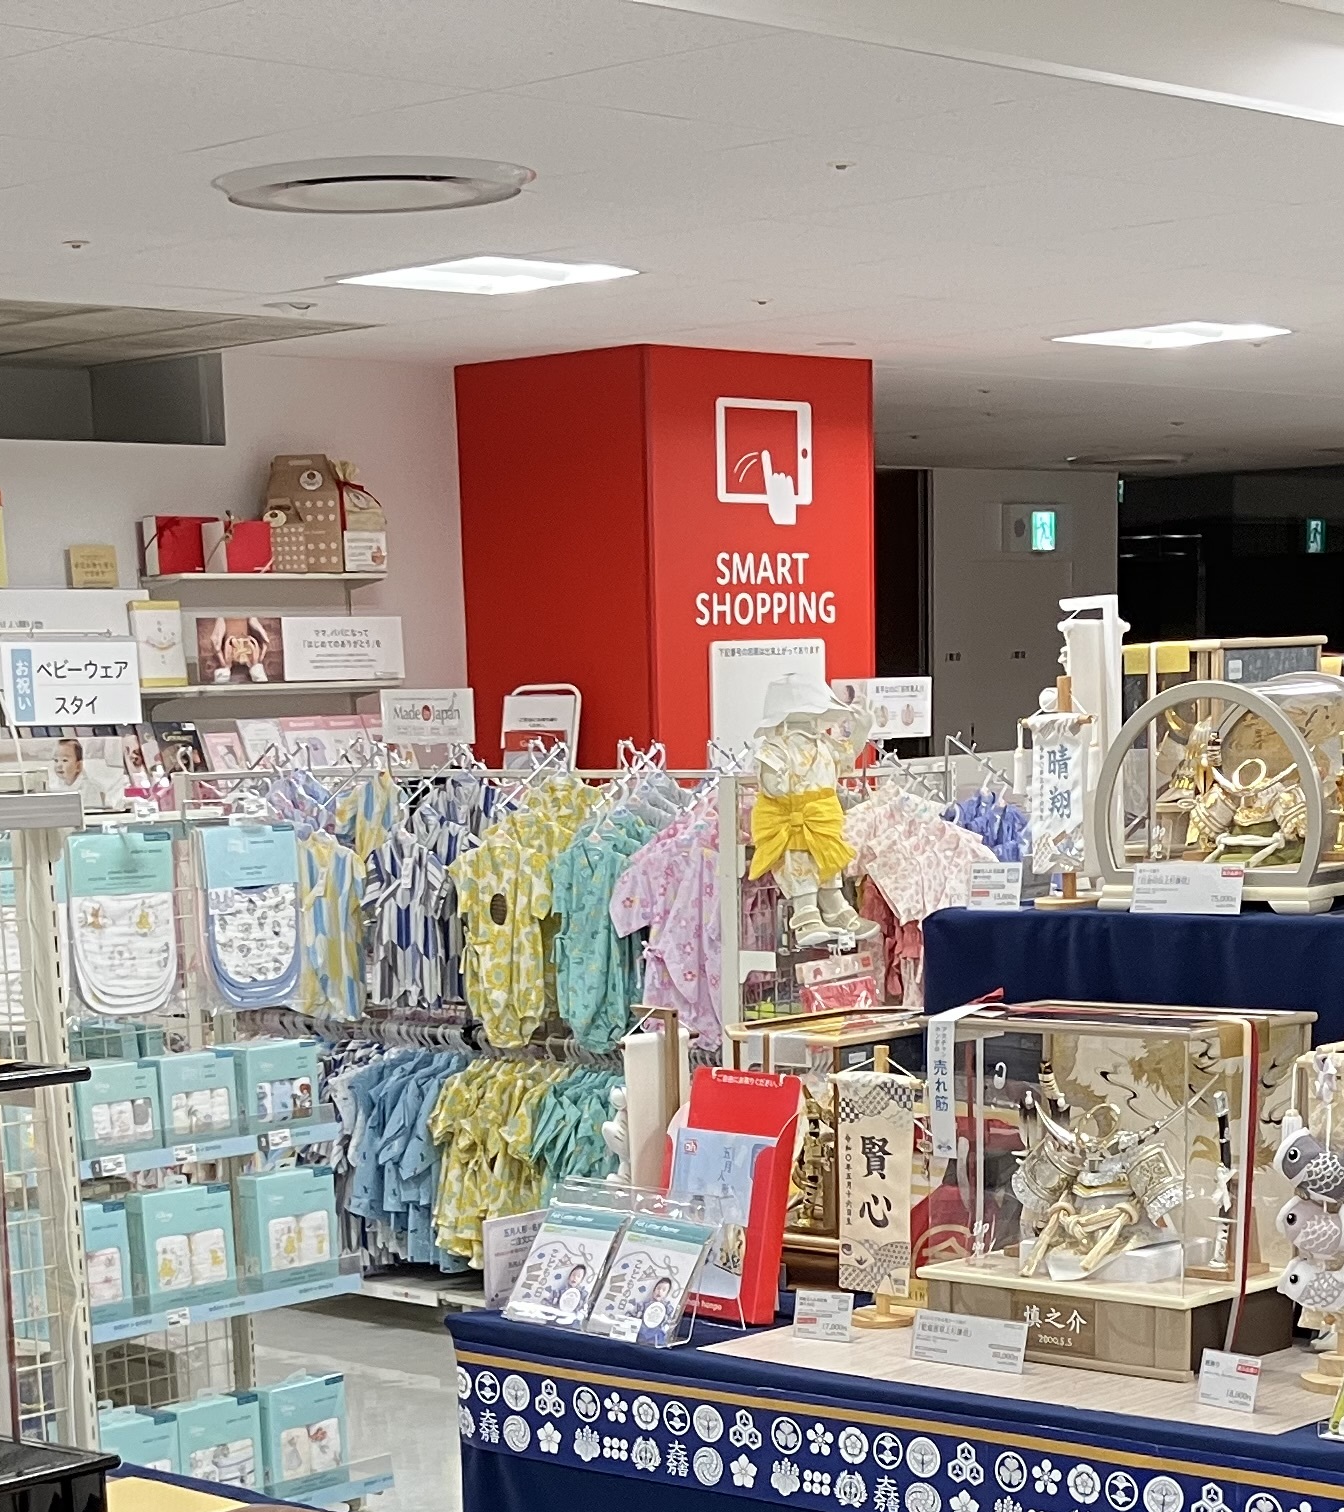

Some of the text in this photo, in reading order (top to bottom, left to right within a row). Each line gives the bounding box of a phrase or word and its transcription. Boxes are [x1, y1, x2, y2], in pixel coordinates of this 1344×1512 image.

[715, 551, 810, 585] SMART
[694, 592, 837, 626] SHOPPING
[14, 660, 32, 711] お祝い
[35, 658, 129, 682] ベビーウェア
[54, 694, 98, 717] スタイ
[393, 703, 462, 725] Made Japan
[1046, 743, 1072, 820] 晴翔
[933, 1059, 949, 1112] 売れ筋
[859, 1135, 893, 1230] 賢心
